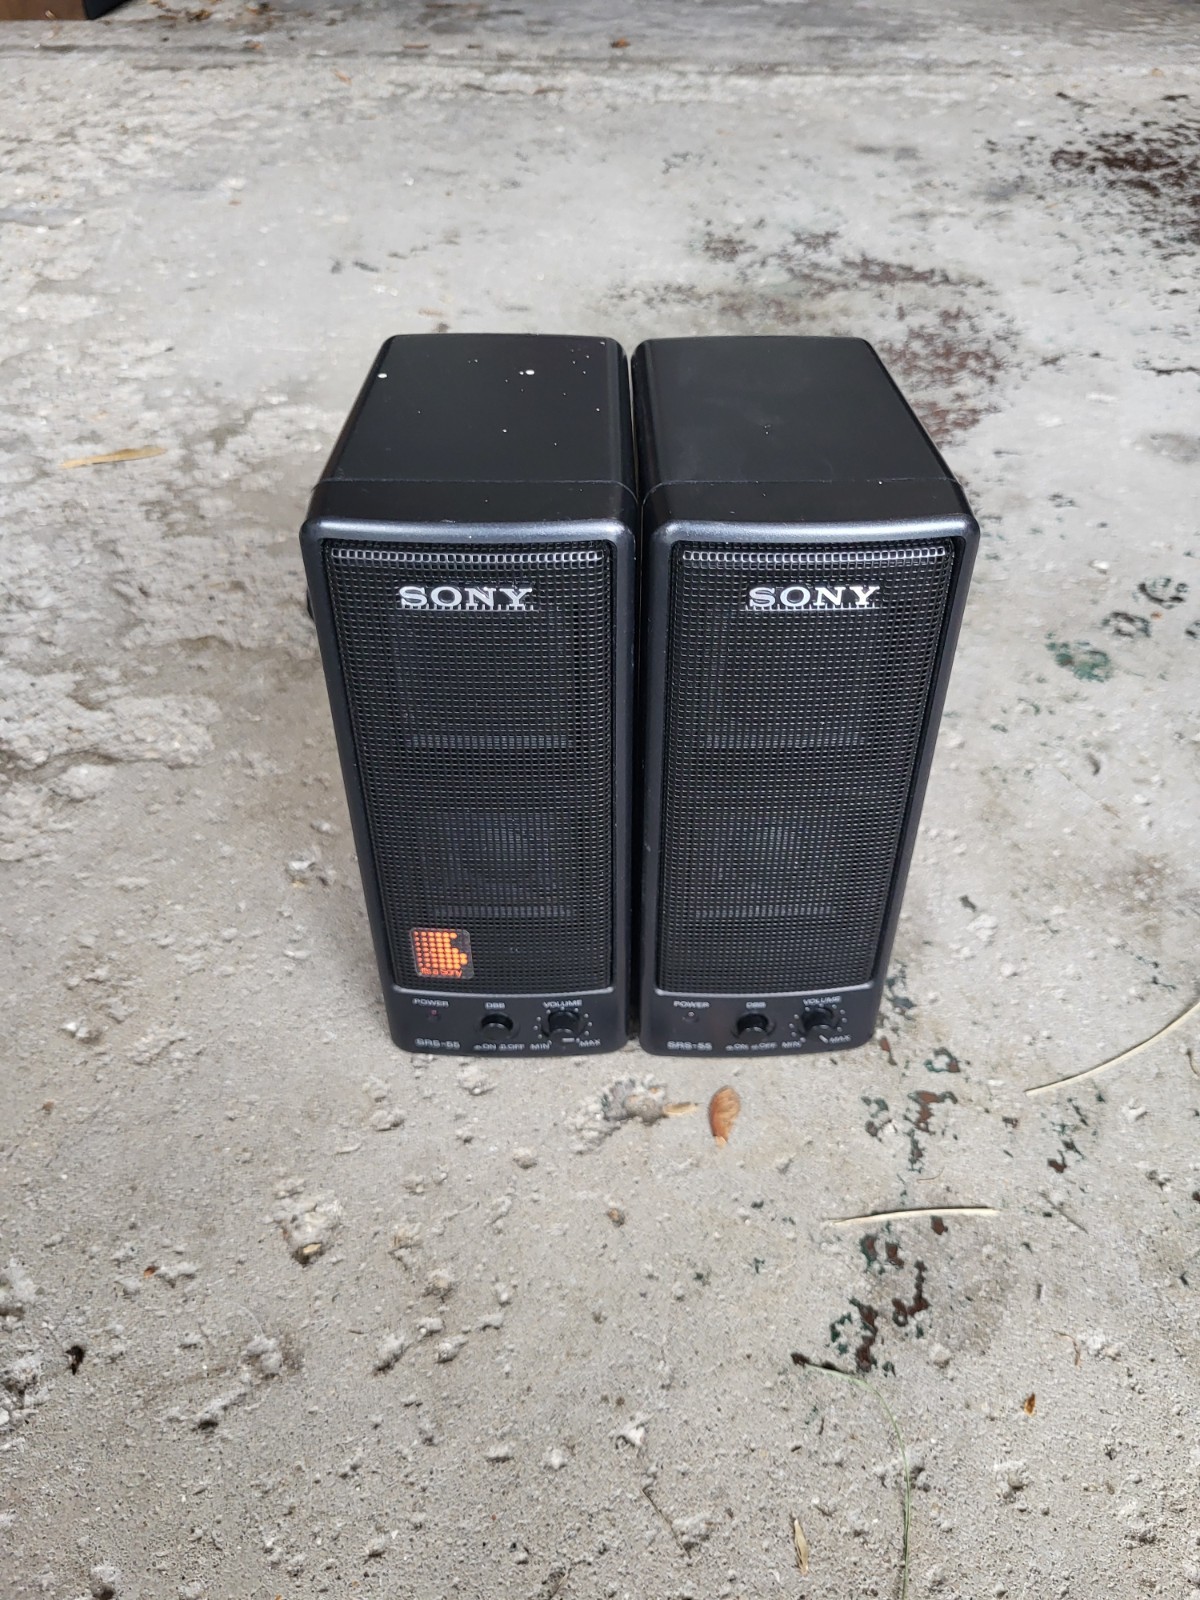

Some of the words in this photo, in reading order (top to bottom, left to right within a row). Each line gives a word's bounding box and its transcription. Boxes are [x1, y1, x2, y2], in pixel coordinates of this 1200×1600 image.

[399, 586, 533, 607] SONY
[749, 586, 880, 607] SONY
[412, 998, 449, 1008] POWER
[485, 1002, 505, 1010] DBB
[542, 999, 582, 1009] VOLUME
[673, 1000, 710, 1009] POWER
[803, 996, 842, 1006] VOLUME
[530, 1043, 550, 1051] MIN
[579, 1039, 601, 1048] MAX
[734, 1043, 749, 1051] ON
[759, 1042, 777, 1051] OFF
[781, 1041, 801, 1049] MIN
[828, 1034, 851, 1045] MAX
[482, 1043, 497, 1051] ON
[508, 1043, 525, 1051] OFF
